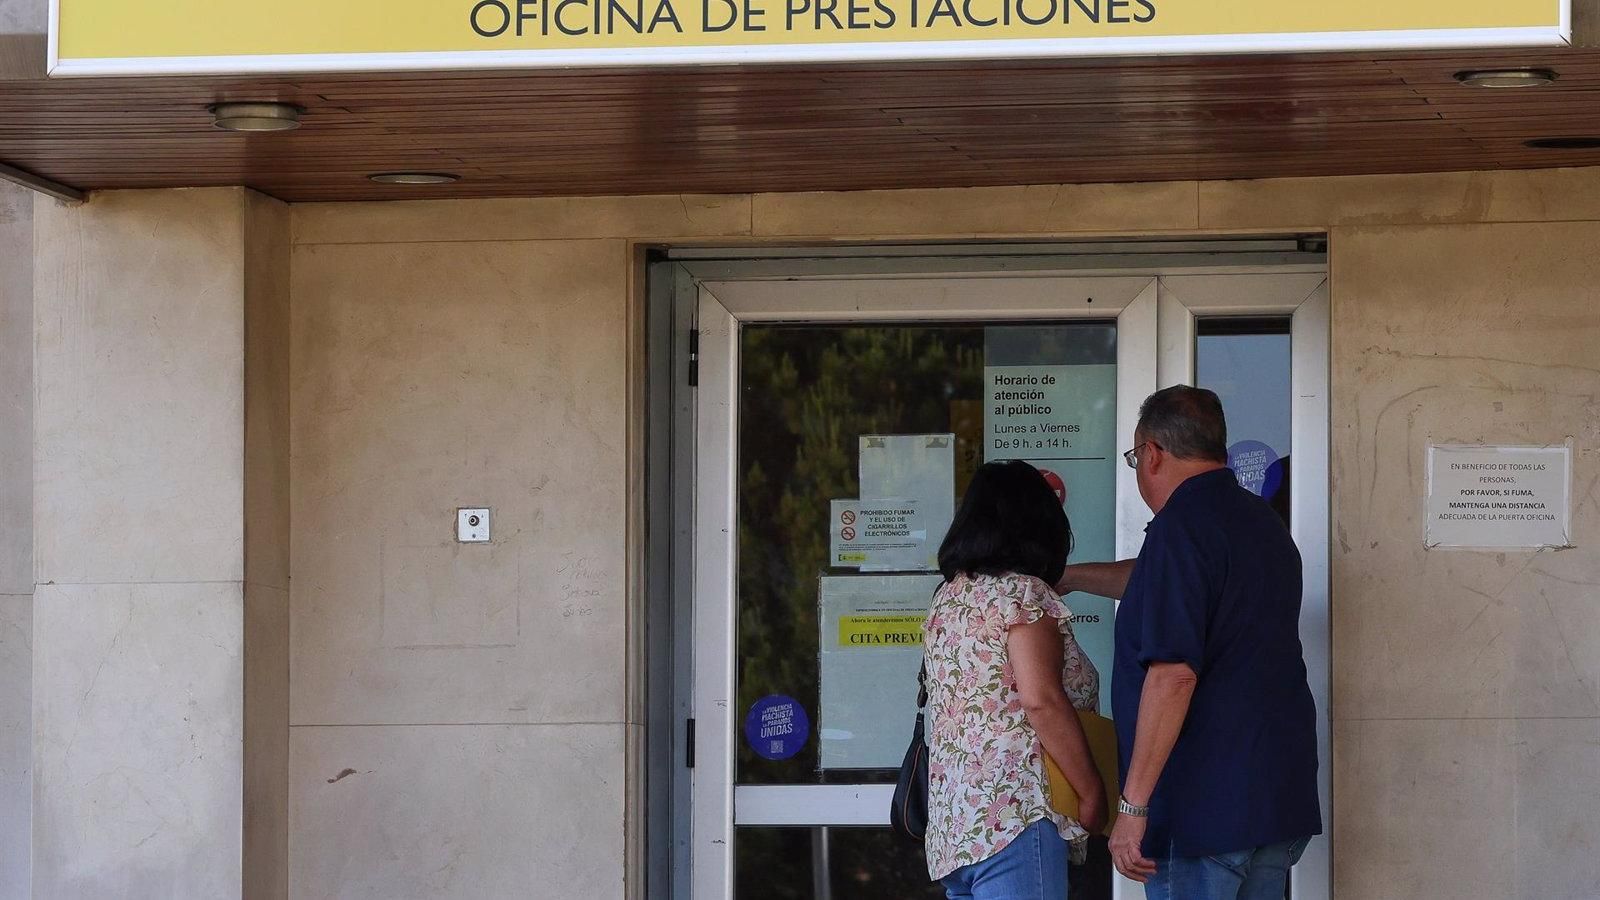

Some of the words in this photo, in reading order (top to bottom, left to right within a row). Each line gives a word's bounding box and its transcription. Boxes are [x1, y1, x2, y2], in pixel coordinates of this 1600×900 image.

[470, 0, 683, 37] OFICINA
[702, 0, 766, 32] DE
[785, 0, 1156, 30] PRESTACIONES
[994, 374, 1038, 386] Horario
[1041, 374, 1056, 385] de
[994, 389, 1045, 400] atención
[994, 405, 1005, 415] al
[1008, 404, 1052, 417] público
[994, 424, 1027, 434] Lunes
[1040, 423, 1081, 433] Viernes
[994, 439, 1010, 449] De
[1013, 438, 1020, 448] 9
[1022, 438, 1032, 448] h.
[1047, 438, 1058, 448] 14
[1062, 438, 1072, 448] h.
[1234, 456, 1267, 468] MACHISTA
[1509, 463, 1532, 471] TODAS
[1533, 463, 1546, 471] LAS
[1480, 476, 1517, 484] PERSONAS,
[1476, 489, 1502, 497] FAVOR,
[1511, 489, 1535, 497] FUMA,
[864, 529, 910, 537] ELECTRÓNICOS
[1070, 614, 1100, 623] erros
[850, 633, 881, 644] CITA
[884, 633, 923, 643] PREVI
[761, 709, 794, 722] MACHISTA
[760, 723, 793, 739] UNIDAS
